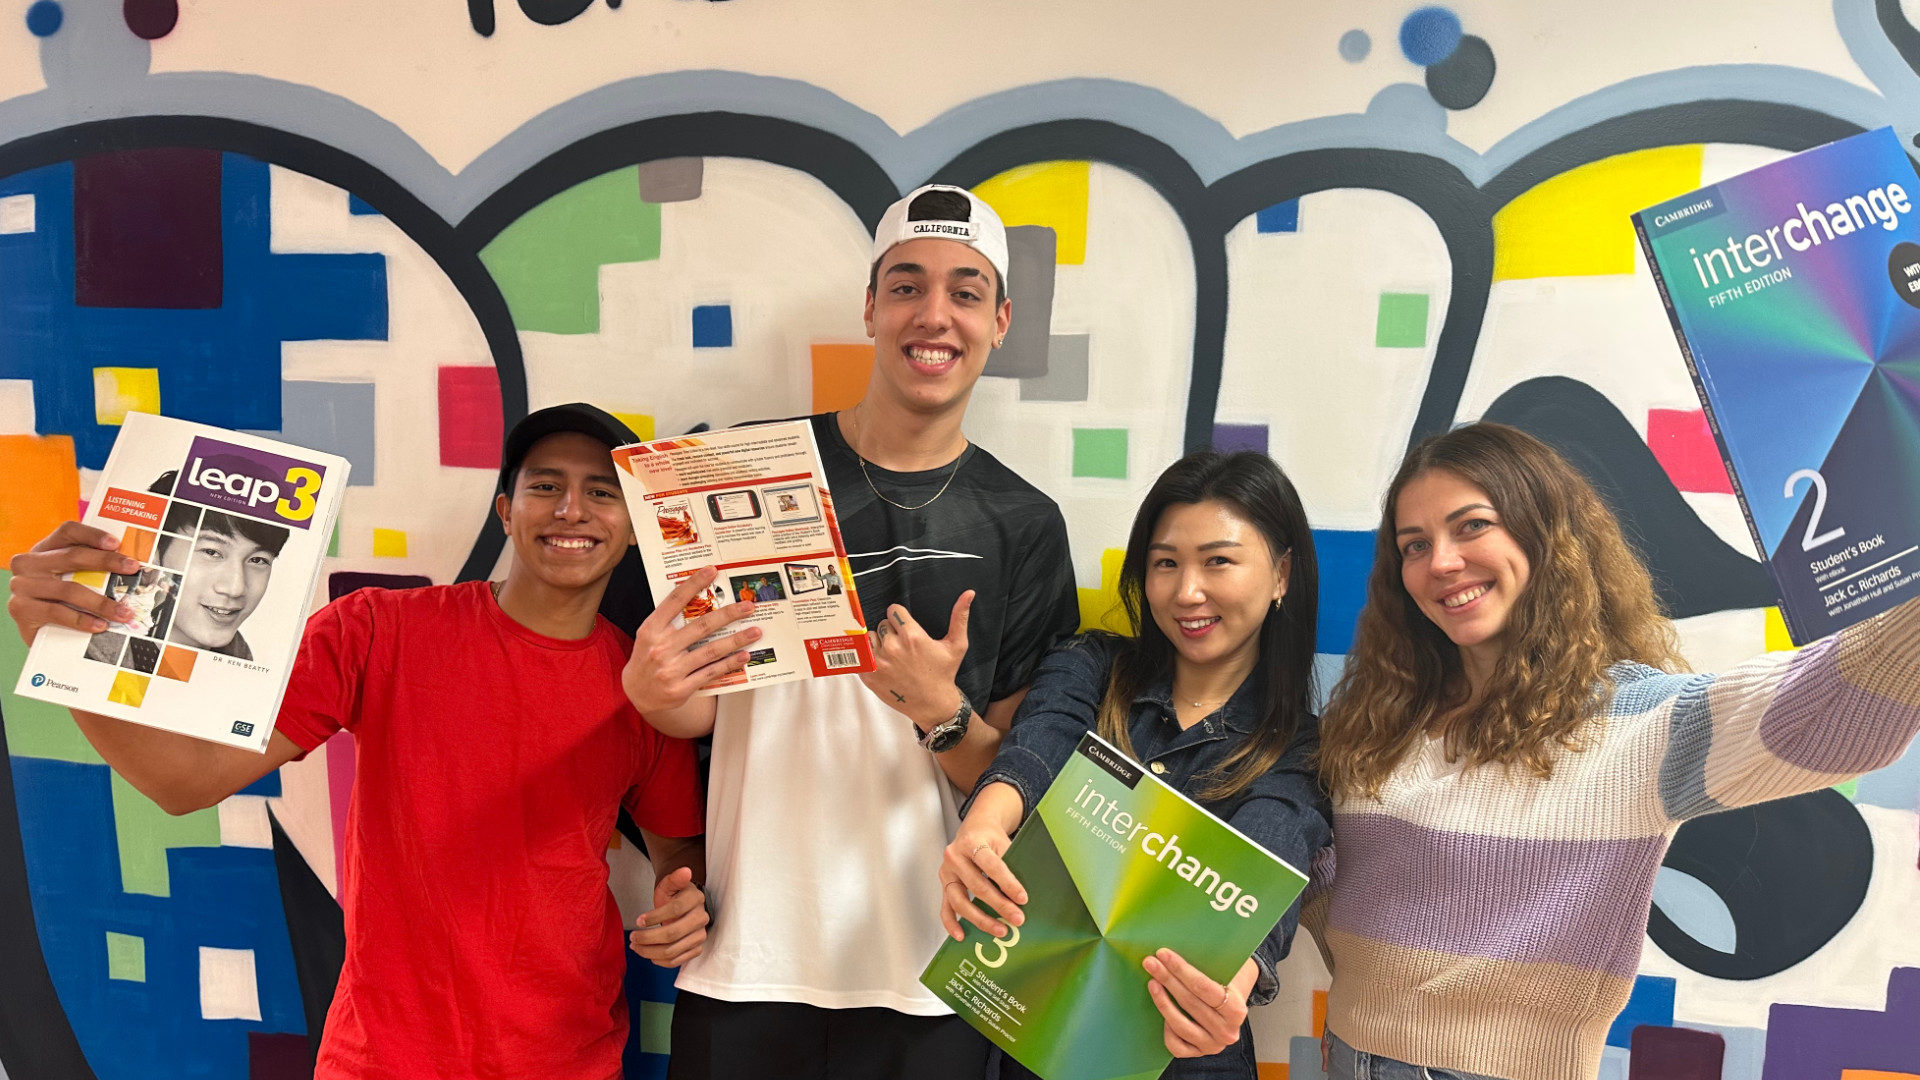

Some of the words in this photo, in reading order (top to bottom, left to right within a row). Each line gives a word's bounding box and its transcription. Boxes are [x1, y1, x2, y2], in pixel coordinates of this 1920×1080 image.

[913, 224, 970, 237] CALIFORNIA
[1689, 183, 1912, 289] interchange
[1709, 286, 1743, 309] FIFTH
[1746, 266, 1793, 295] EDITION
[1672, 329, 1697, 376] interchange
[1696, 384, 1707, 404] FIFTH
[1704, 406, 1718, 434] EDITION
[1739, 497, 1749, 515] BOOK
[104, 504, 120, 512] AND
[121, 507, 157, 520] SPEAKING
[108, 496, 145, 509] LISTENING
[223, 496, 246, 504] EDITION
[1784, 468, 1846, 552] 2
[1810, 546, 1858, 573] Student's
[1858, 534, 1884, 553] Book
[1828, 566, 1845, 577] eBook
[1824, 589, 1846, 607] Jack
[1846, 583, 1858, 596] C.
[1858, 566, 1901, 591] Richards
[1828, 606, 1842, 616] with
[1843, 594, 1870, 610] Jonathan
[1870, 588, 1882, 598] Hull
[1882, 583, 1894, 593] and
[1894, 575, 1911, 587] Susan
[46, 678, 78, 692] Pearson
[243, 663, 269, 673] BEATTY
[1065, 807, 1090, 829] FIFTH
[1091, 825, 1127, 855] EDITION
[1074, 778, 1259, 918] interchange
[975, 917, 1020, 968] 3
[948, 978, 963, 992] Jack
[963, 989, 971, 998] C.
[971, 995, 1000, 1021] Richards
[976, 971, 1008, 998] Student's
[1007, 996, 1026, 1013] Book
[945, 985, 954, 993] with
[953, 992, 972, 1008] Jonathan
[971, 1006, 980, 1015] Hull
[979, 1013, 988, 1021] and
[987, 1019, 1000, 1030] Susan
[1000, 1029, 1016, 1042] Proctor
